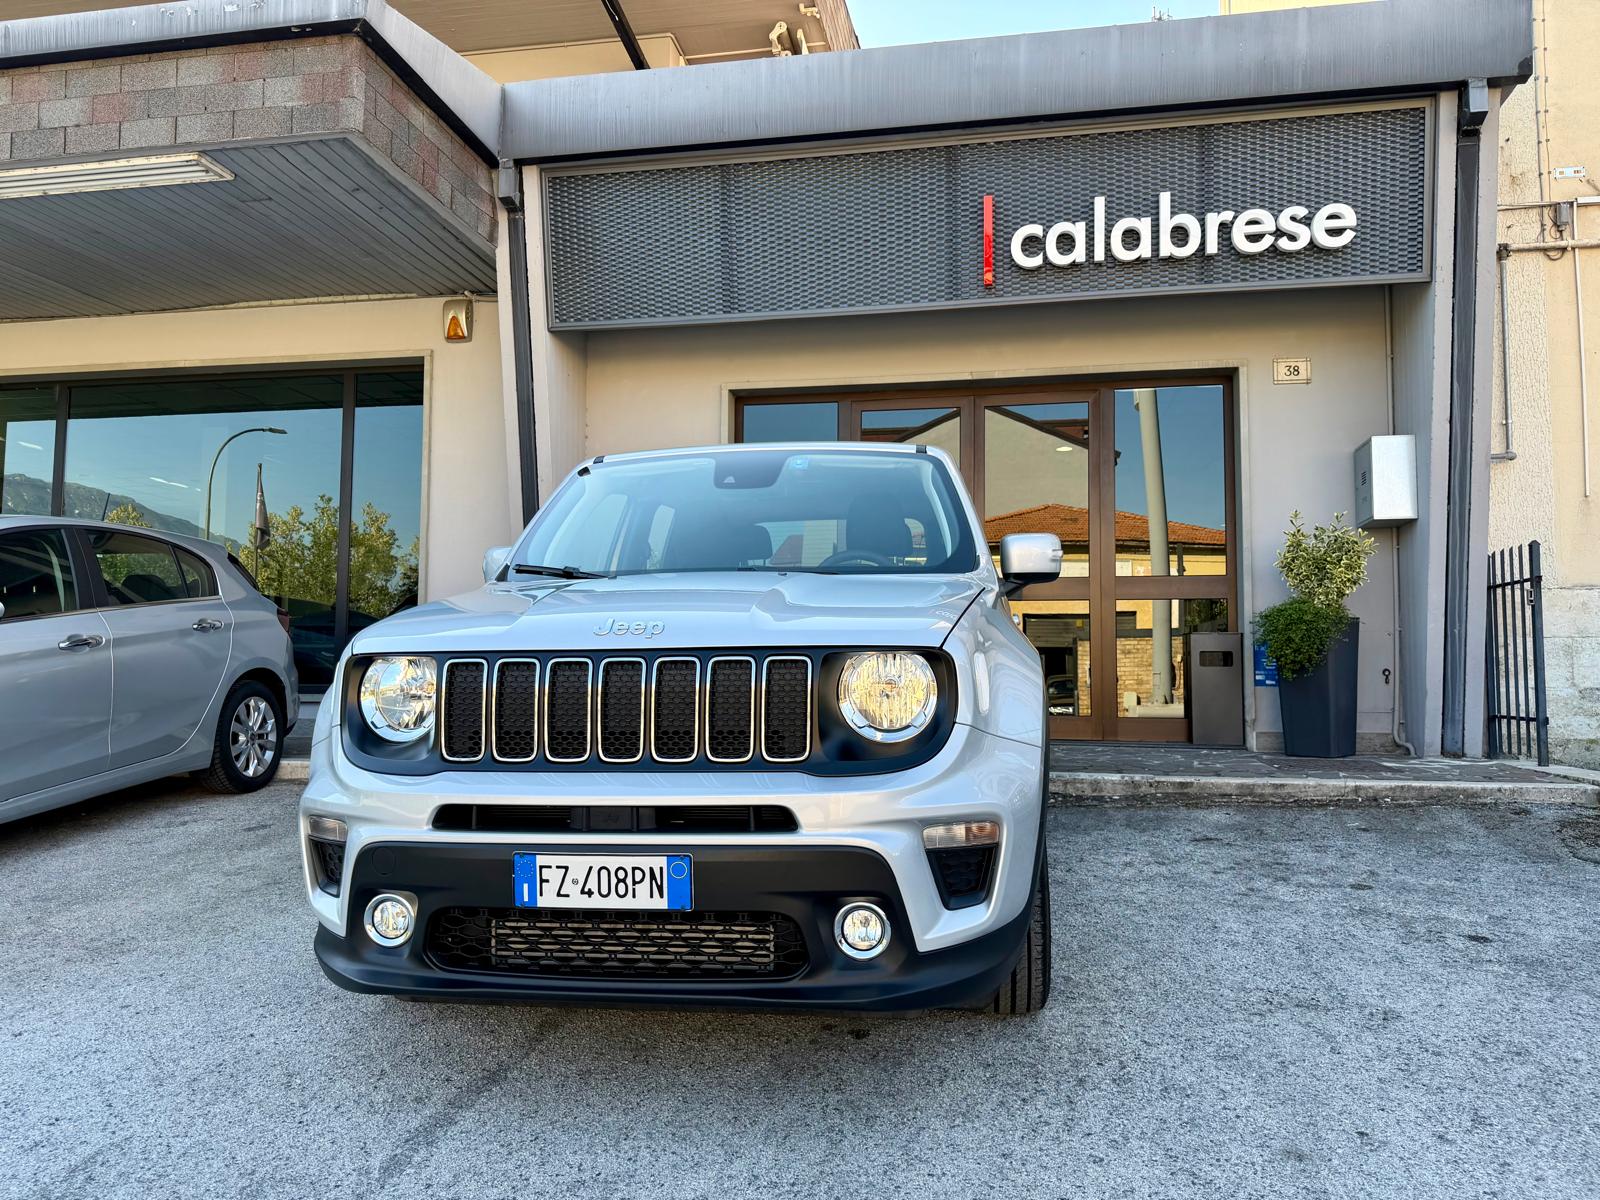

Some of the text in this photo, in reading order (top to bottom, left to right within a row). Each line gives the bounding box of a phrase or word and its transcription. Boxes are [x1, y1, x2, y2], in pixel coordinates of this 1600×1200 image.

[1010, 191, 1358, 270] calabrese
[1284, 365, 1300, 376] 38
[592, 617, 665, 639] Jeep
